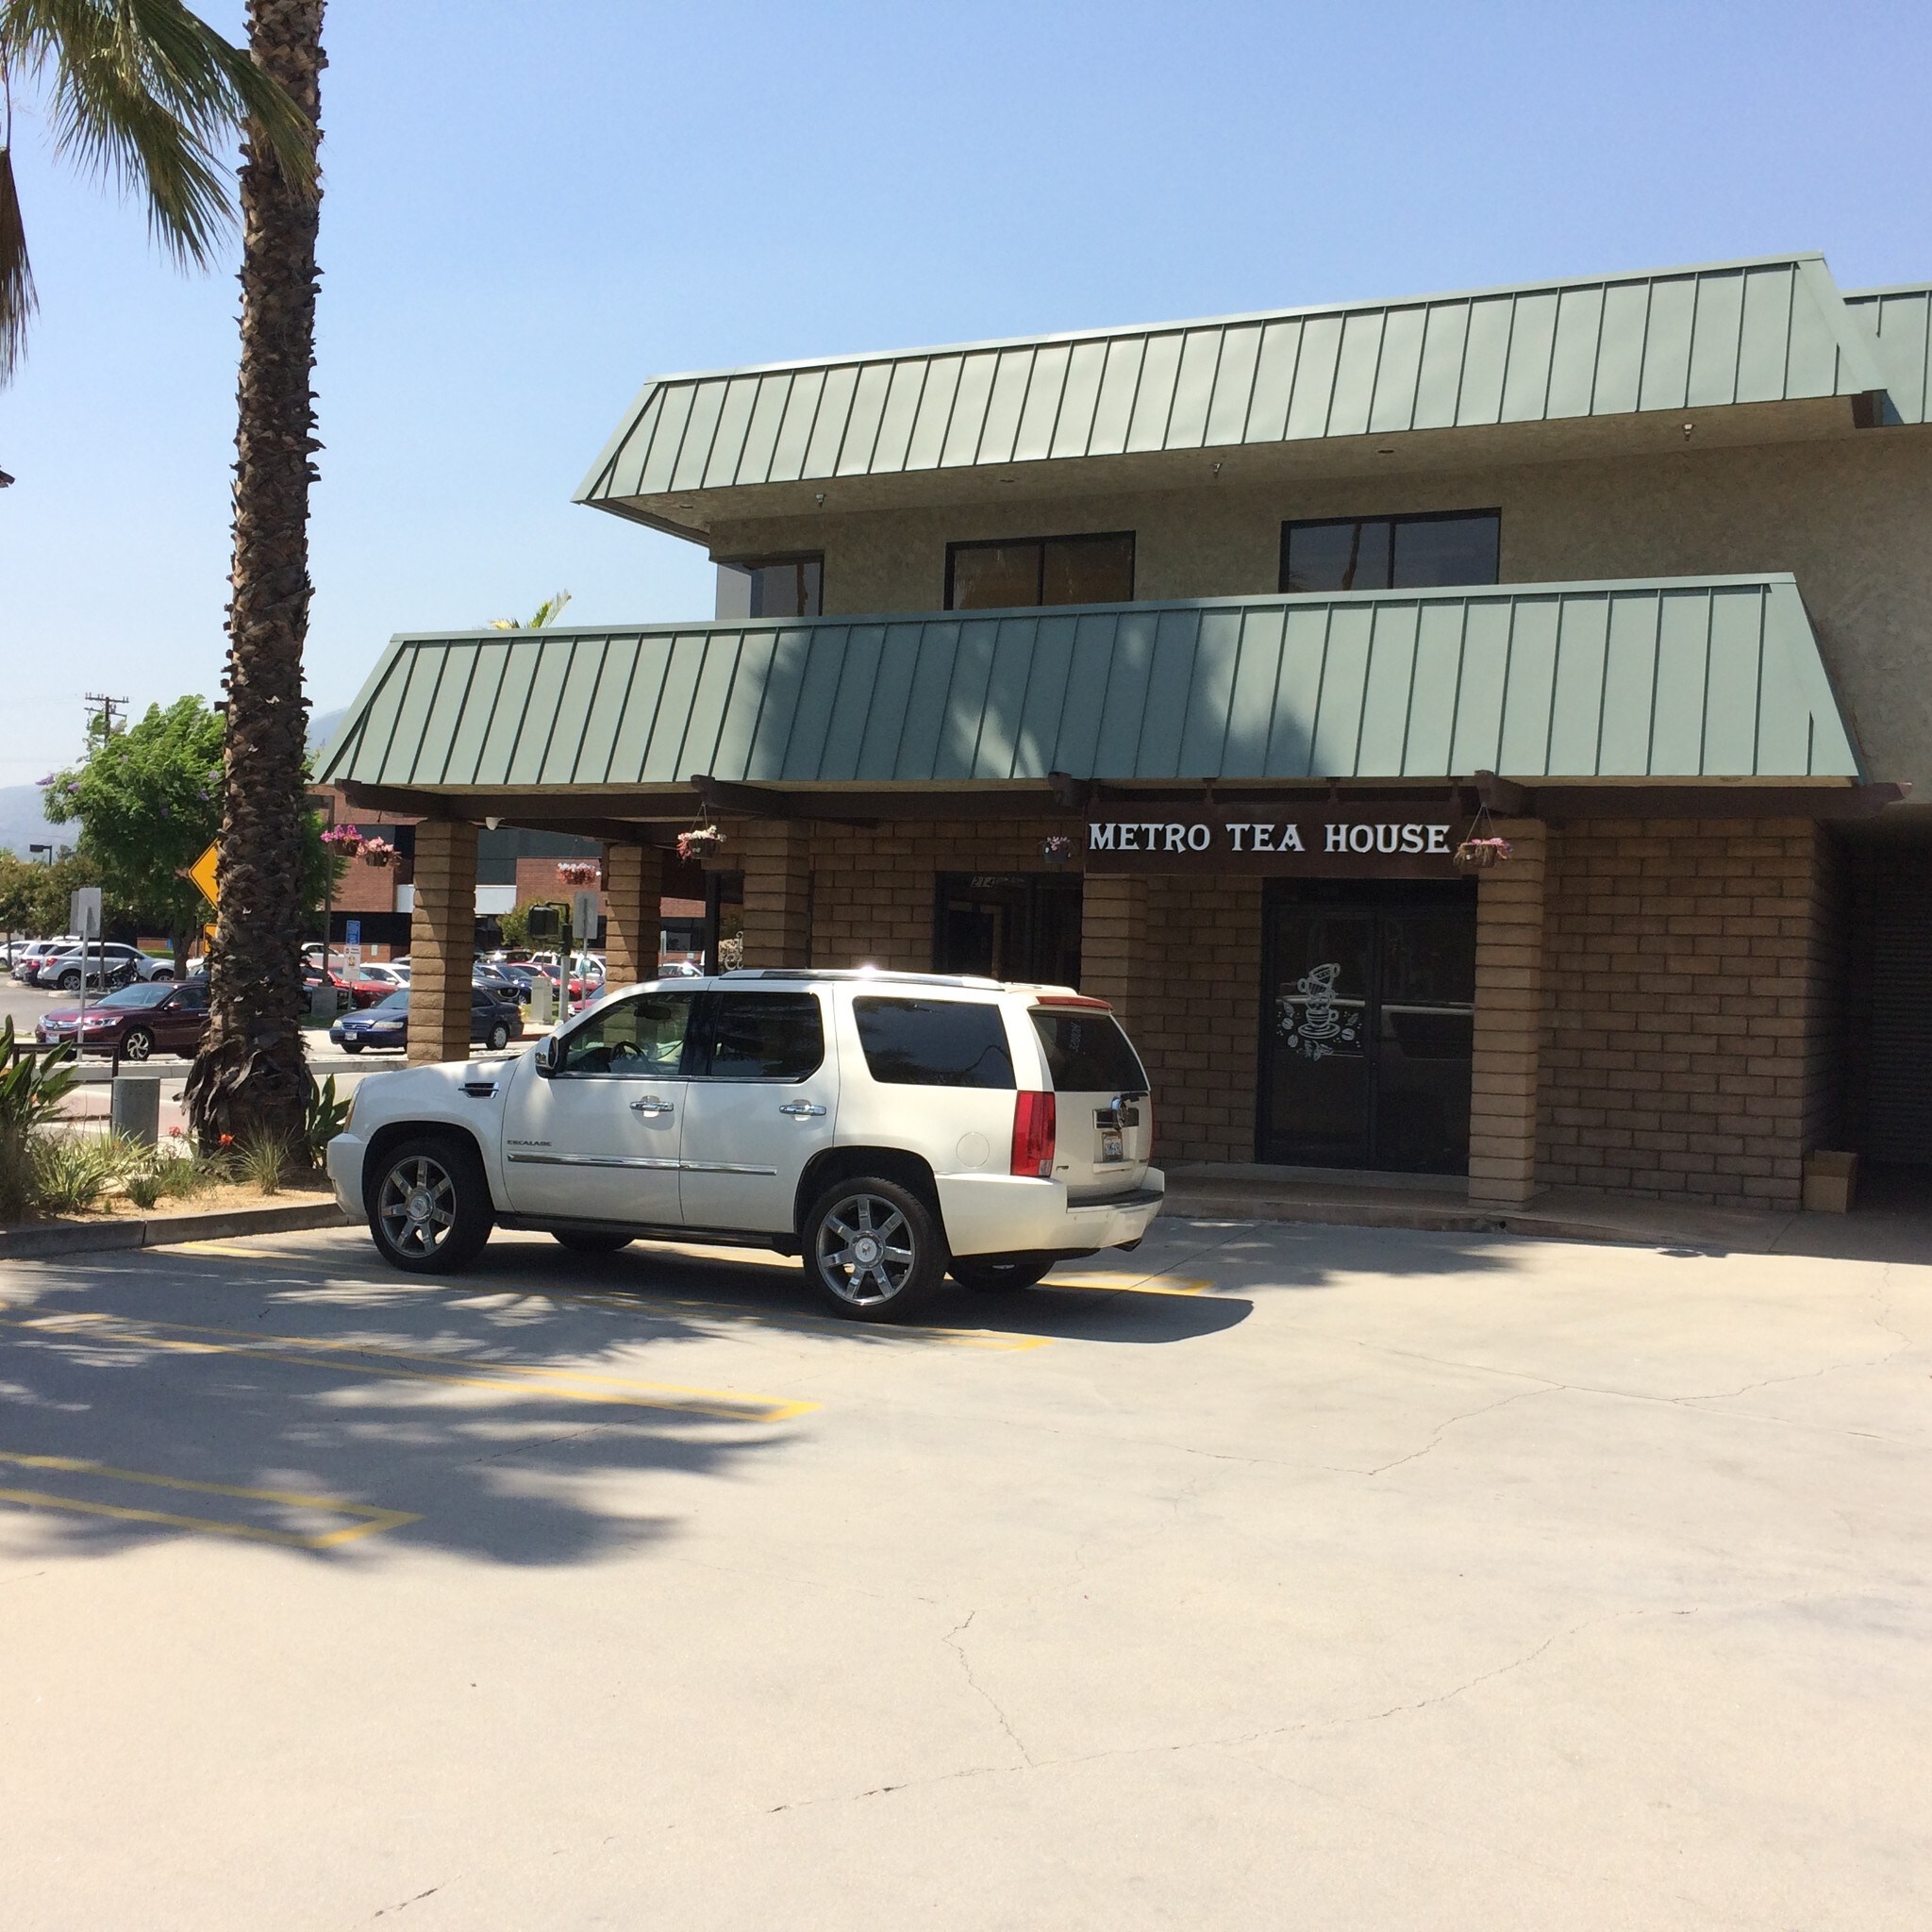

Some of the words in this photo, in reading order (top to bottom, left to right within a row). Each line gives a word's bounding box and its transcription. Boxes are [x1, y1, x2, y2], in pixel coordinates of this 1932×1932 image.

[1088, 823, 1211, 854] METRO
[1225, 824, 1306, 853] TEA
[1323, 824, 1452, 855] HOUSE
